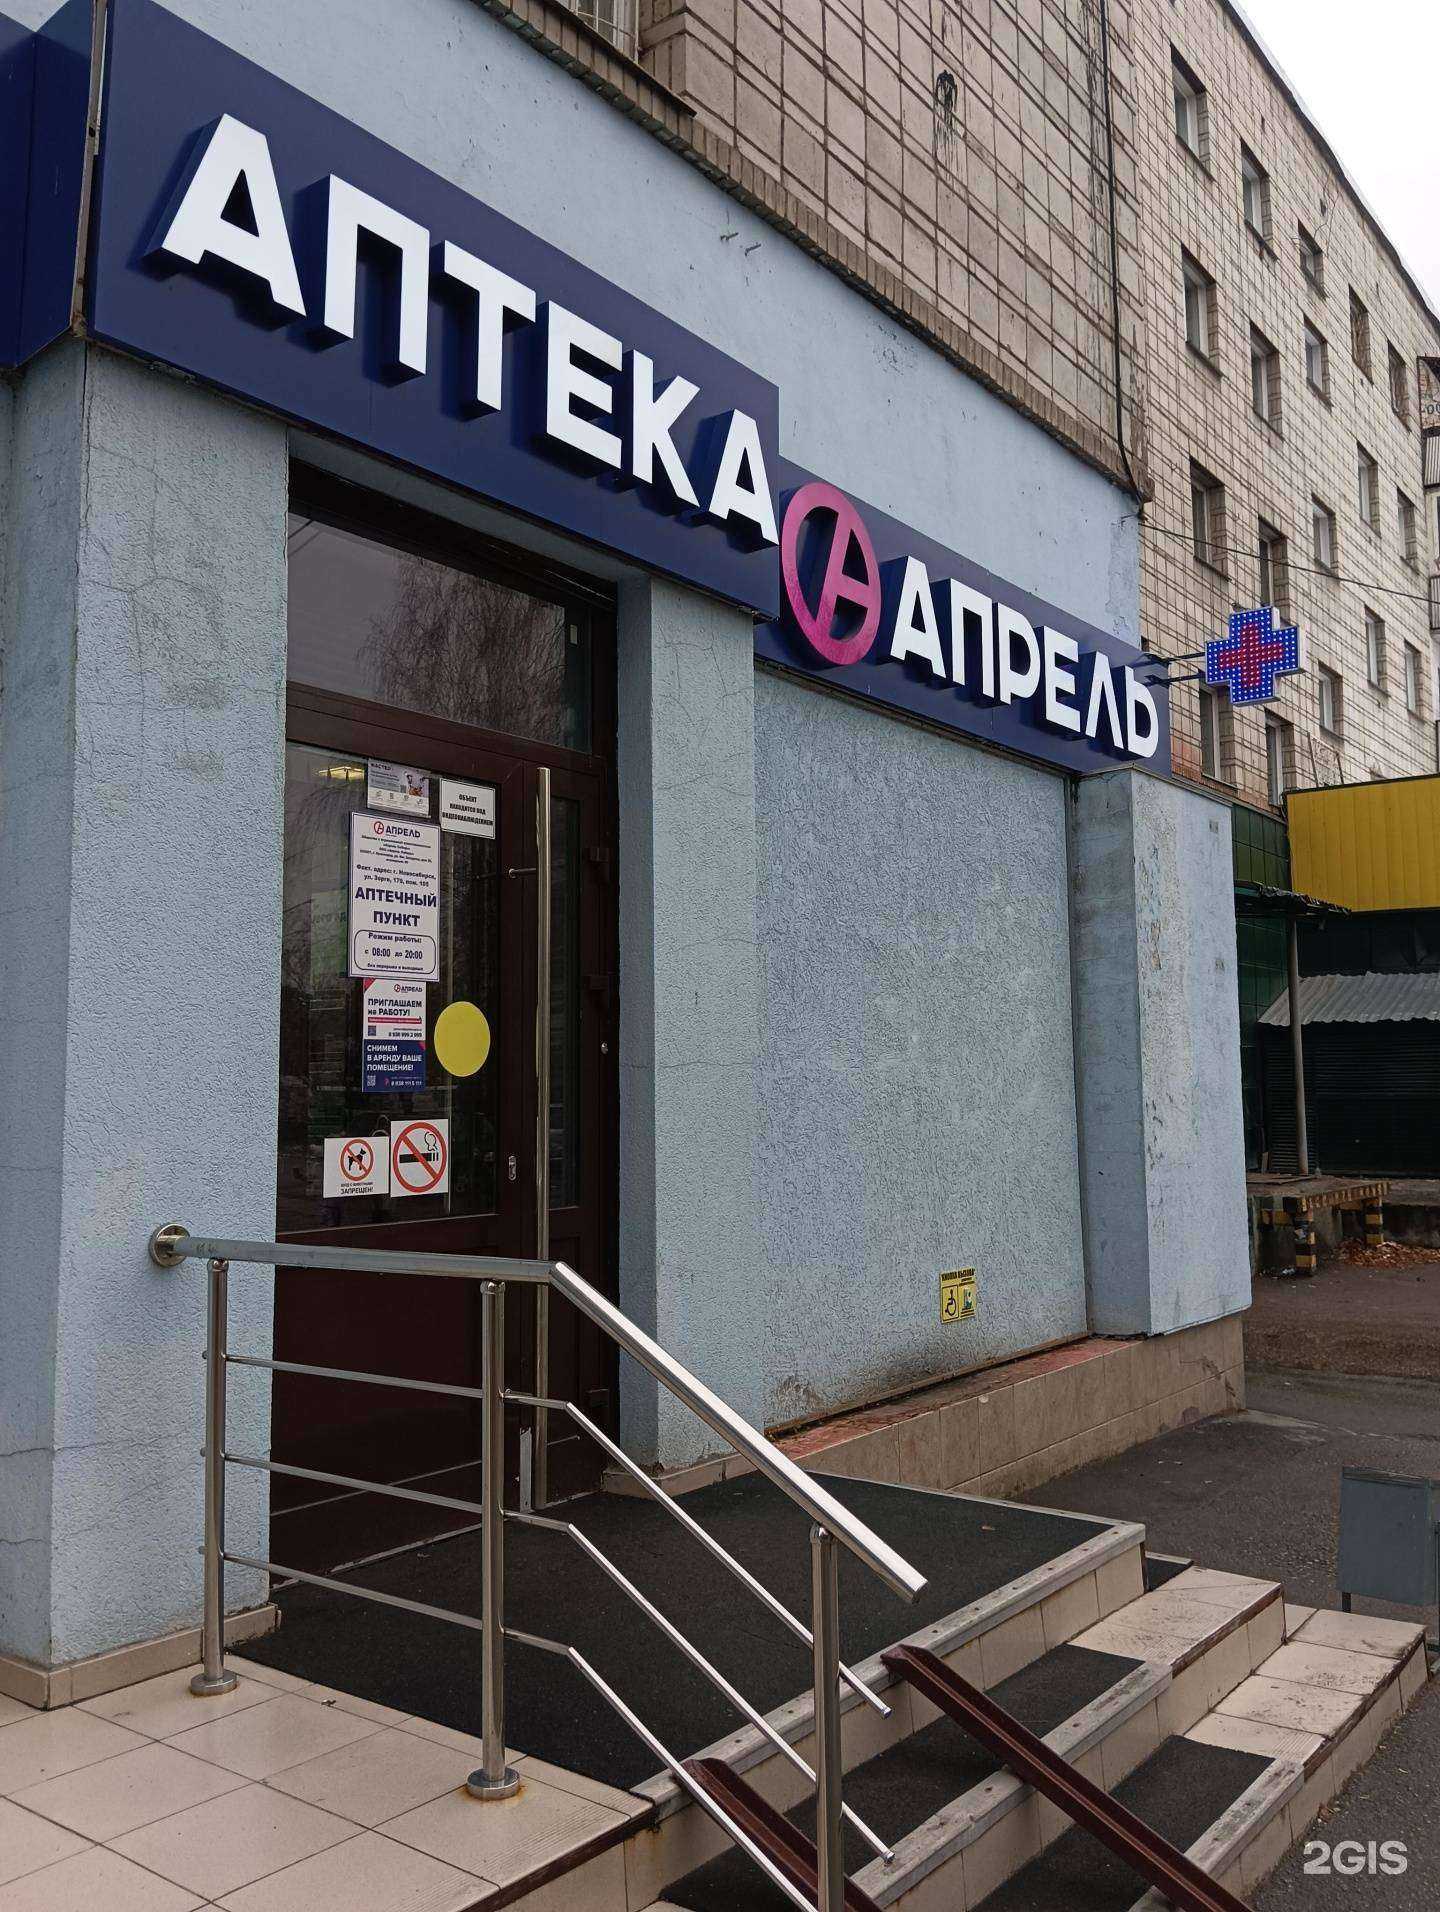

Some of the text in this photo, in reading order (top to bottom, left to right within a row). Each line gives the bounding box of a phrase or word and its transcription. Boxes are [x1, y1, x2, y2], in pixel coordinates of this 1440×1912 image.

[161, 113, 780, 546] АПТЕКА
[890, 555, 1160, 759] АПРЕЛЬ
[458, 793, 477, 803] ОБЪЕКТ
[385, 825, 421, 838] АПРЕЛЬ
[354, 886, 437, 908] АПТЕЧНЫЙ
[373, 910, 421, 927] ПУНКТ
[368, 932, 422, 944] Режим работы:
[371, 947, 391, 958] 08:00
[404, 949, 423, 960] 20:00
[400, 985, 423, 993] АПРЕЛЬ
[367, 998, 422, 1008] ПРИГЛАШАЕМ
[378, 1007, 411, 1017] РАБОТУ!
[366, 1044, 398, 1052] СНИМЕМ
[366, 1054, 423, 1063] В АРЕНДУ ВАШЕ
[366, 1063, 414, 1072] ПОМЕЩЕНИЕ!
[340, 1187, 374, 1195] ЗАПРЕЩЕН!
